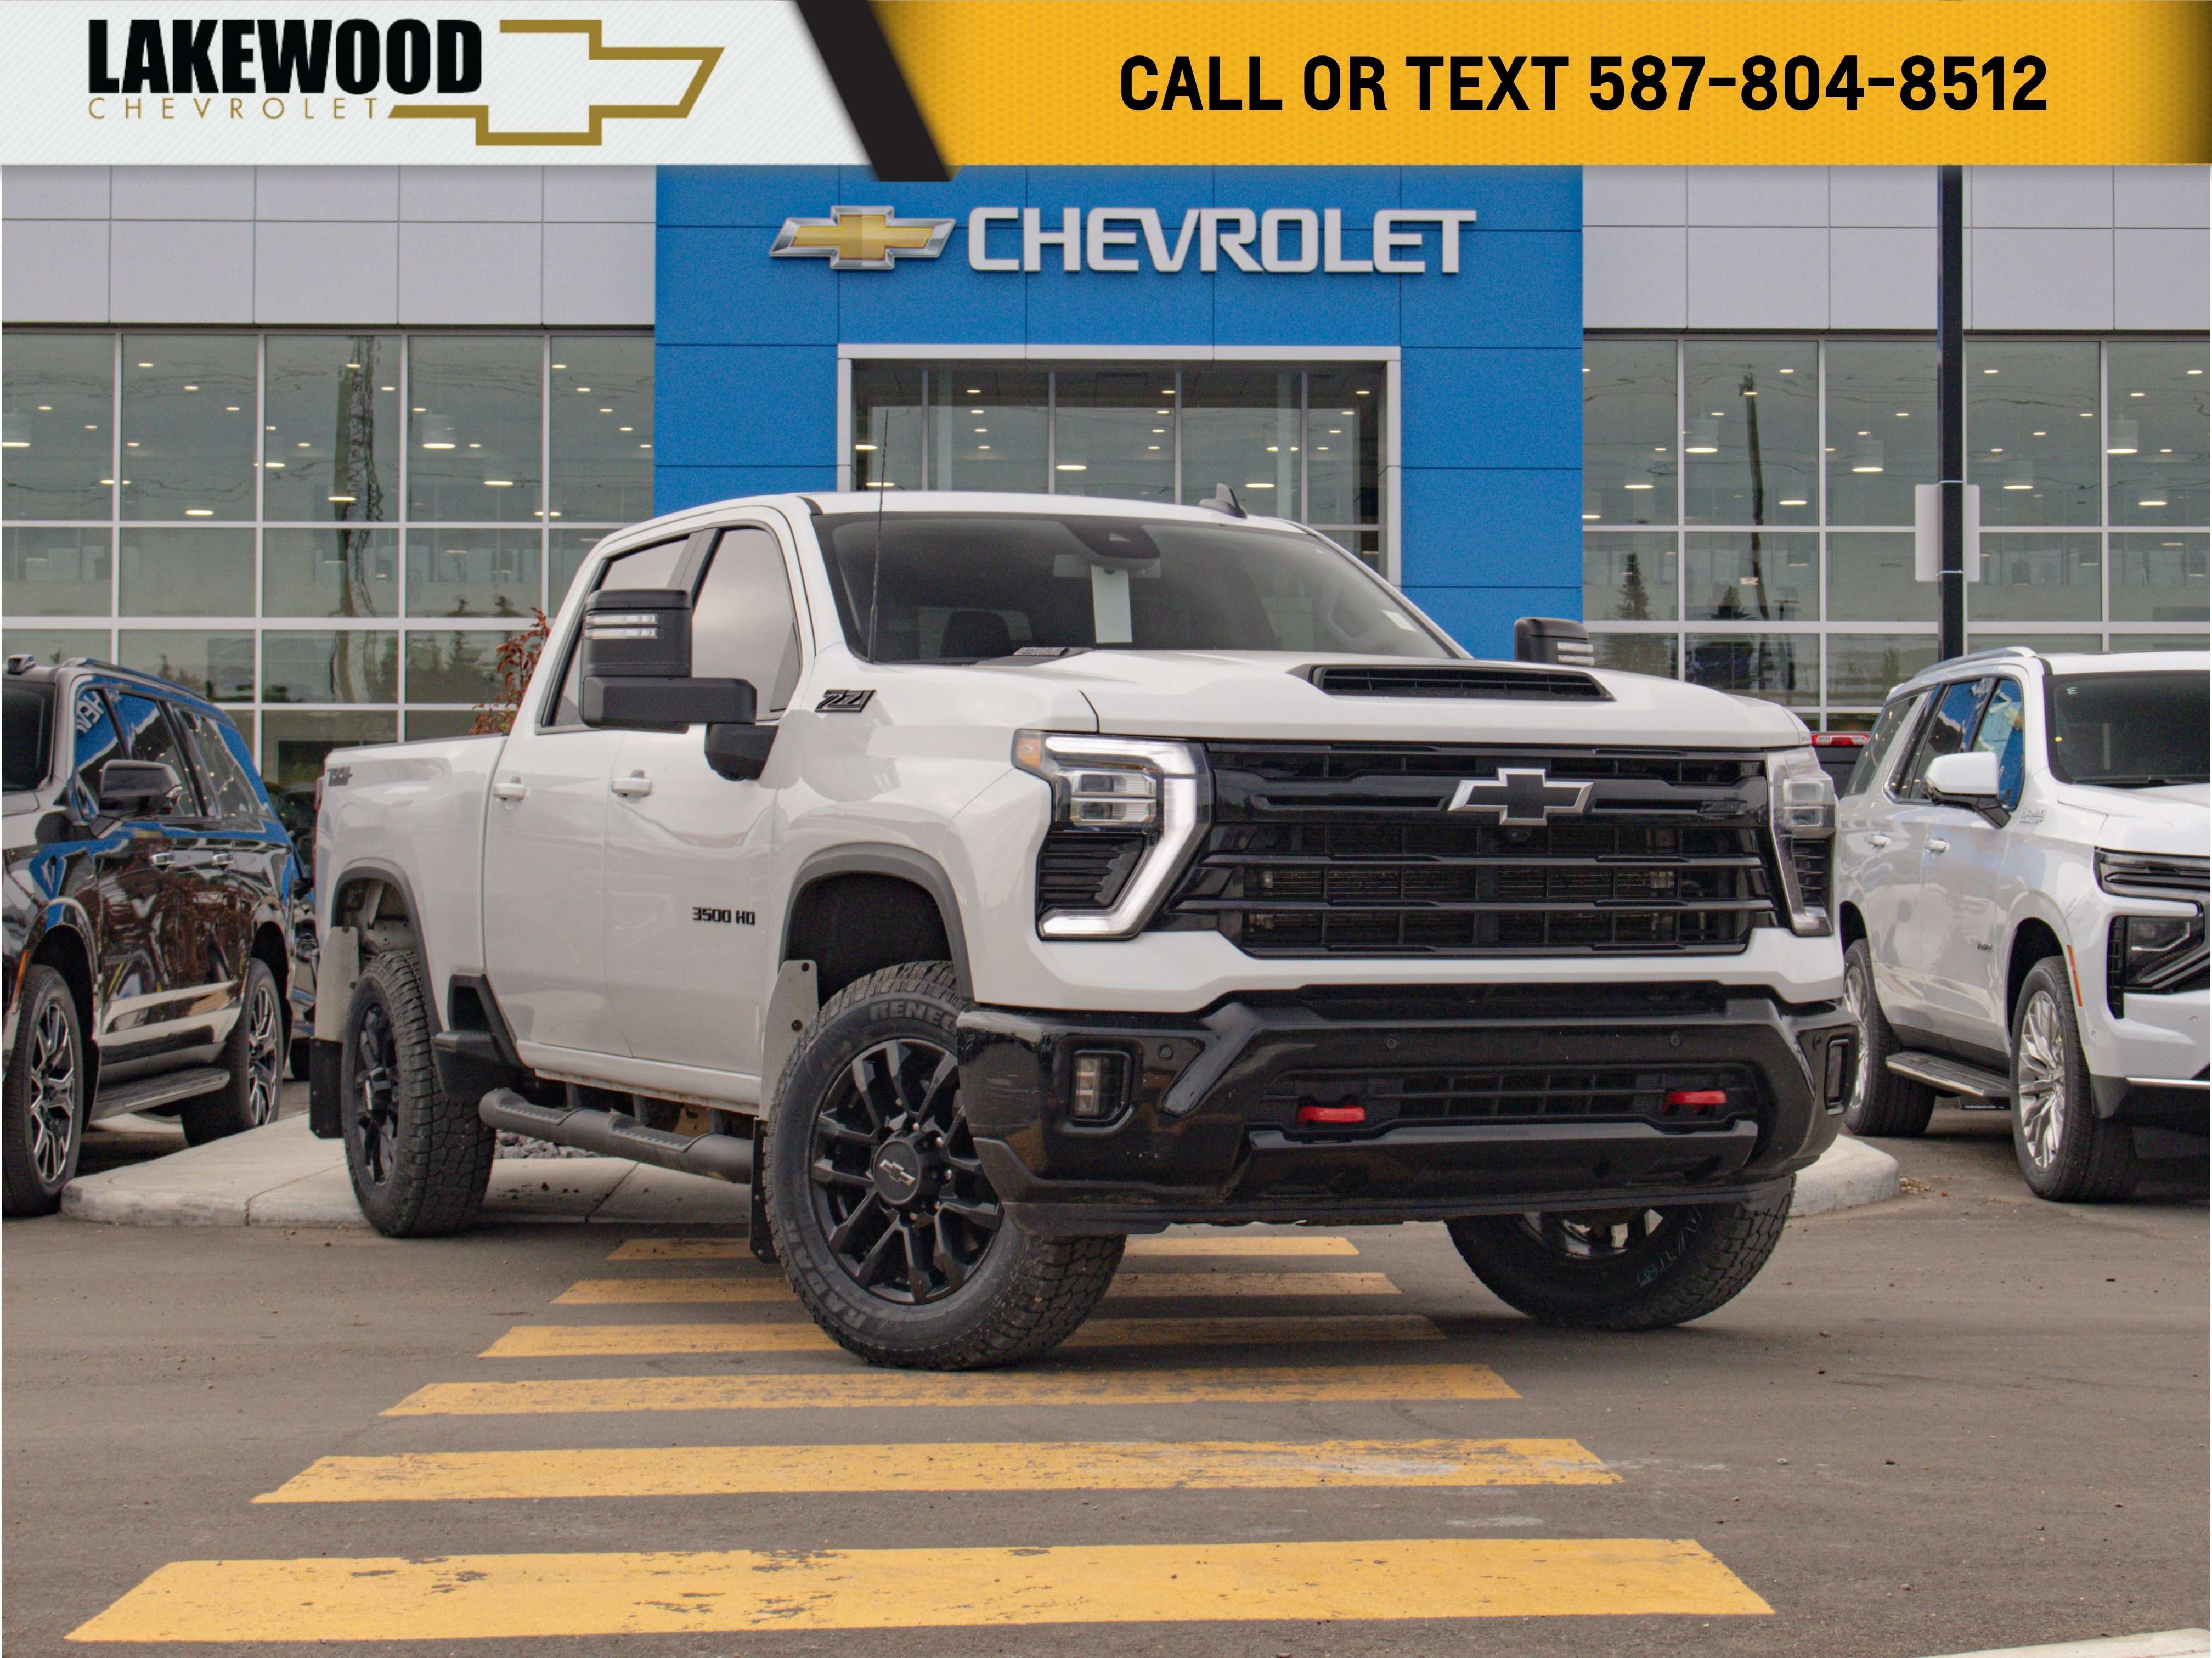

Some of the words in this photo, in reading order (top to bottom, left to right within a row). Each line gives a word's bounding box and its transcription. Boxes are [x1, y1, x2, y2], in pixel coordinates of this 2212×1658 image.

[968, 207, 1477, 273] CHEVROLET
[692, 907, 732, 923] 3500
[736, 909, 755, 926] HD
